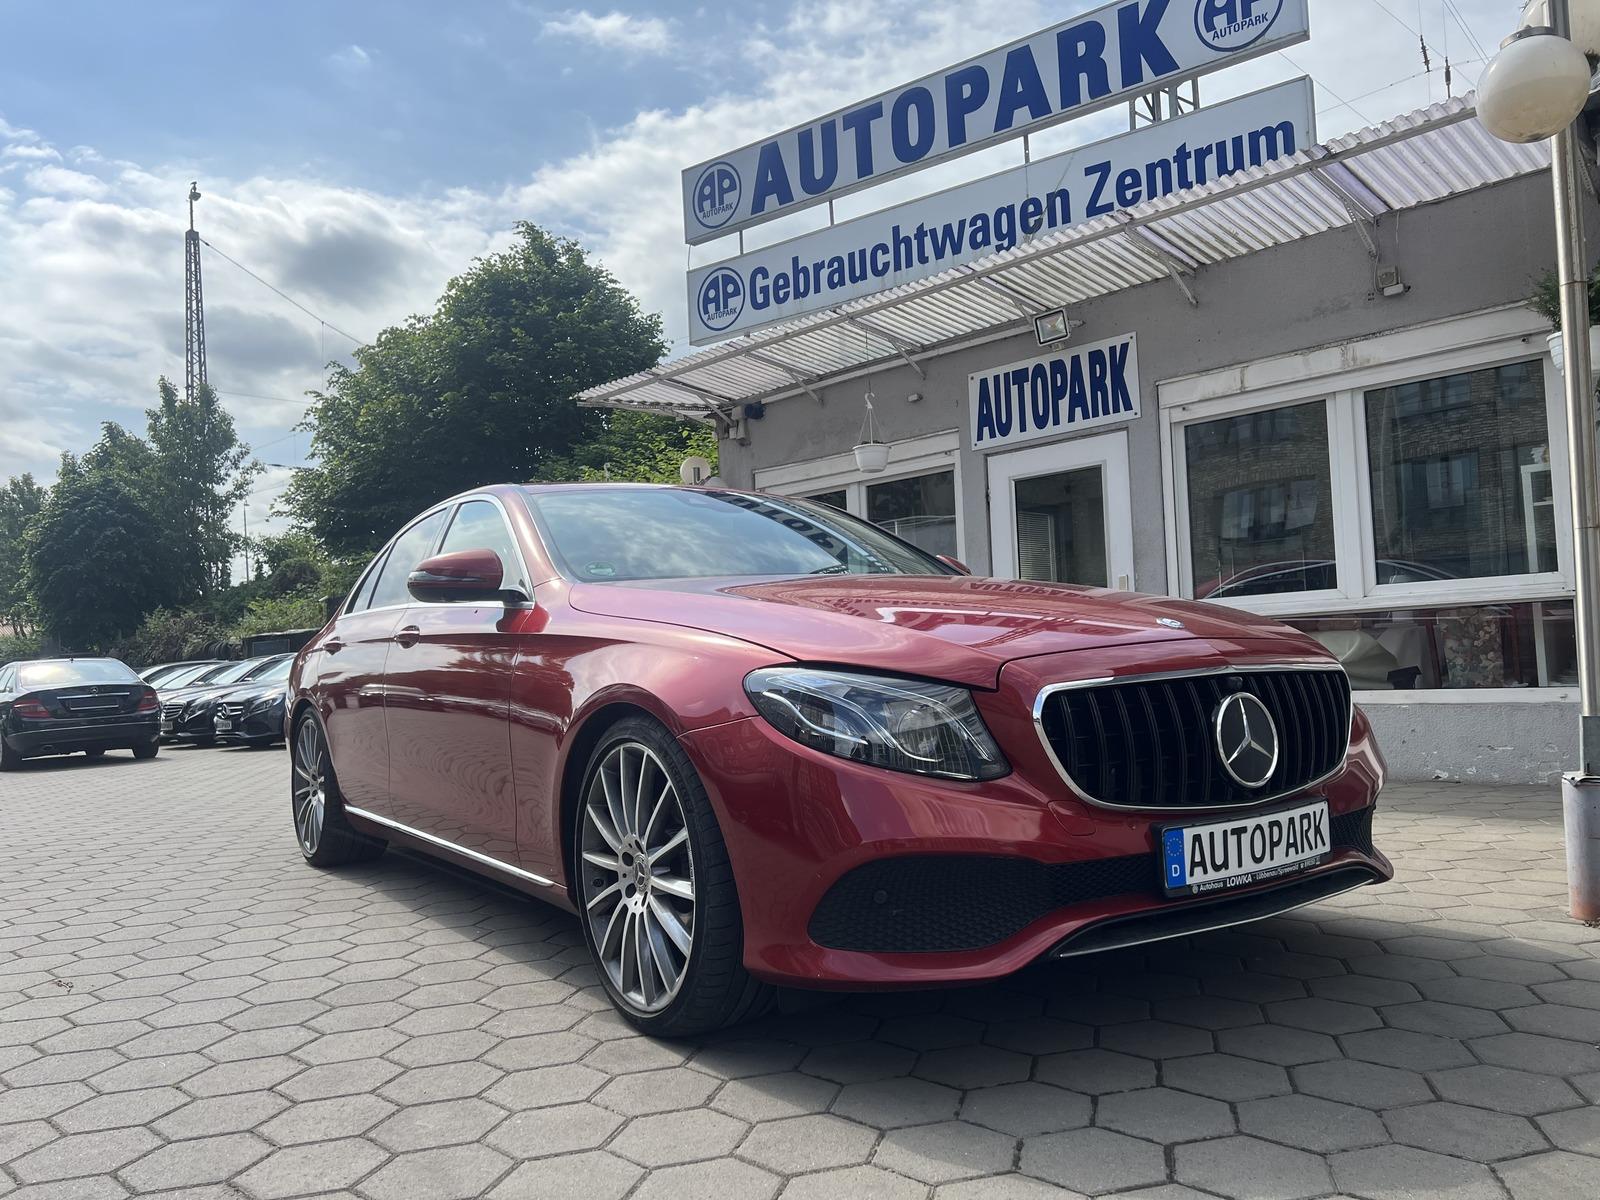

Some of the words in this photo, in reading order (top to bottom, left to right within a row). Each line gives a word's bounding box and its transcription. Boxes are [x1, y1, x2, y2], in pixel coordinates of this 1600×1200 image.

[1212, 12, 1269, 41] AUTOPARK
[751, 0, 1180, 214] AUTOPARK
[698, 168, 738, 213] AP
[702, 202, 734, 219] AUTOPARK
[749, 186, 1071, 310] Gebrauchtwagen
[1084, 121, 1295, 217] Zentrum
[703, 274, 742, 315] AP
[707, 306, 738, 322] AUTOPARK
[977, 342, 1133, 441] AUTOPARK
[1172, 864, 1180, 877] D
[1190, 808, 1326, 877] AUTOPARK
[1199, 881, 1224, 892] Autohaus
[1226, 873, 1253, 888] LOWKA
